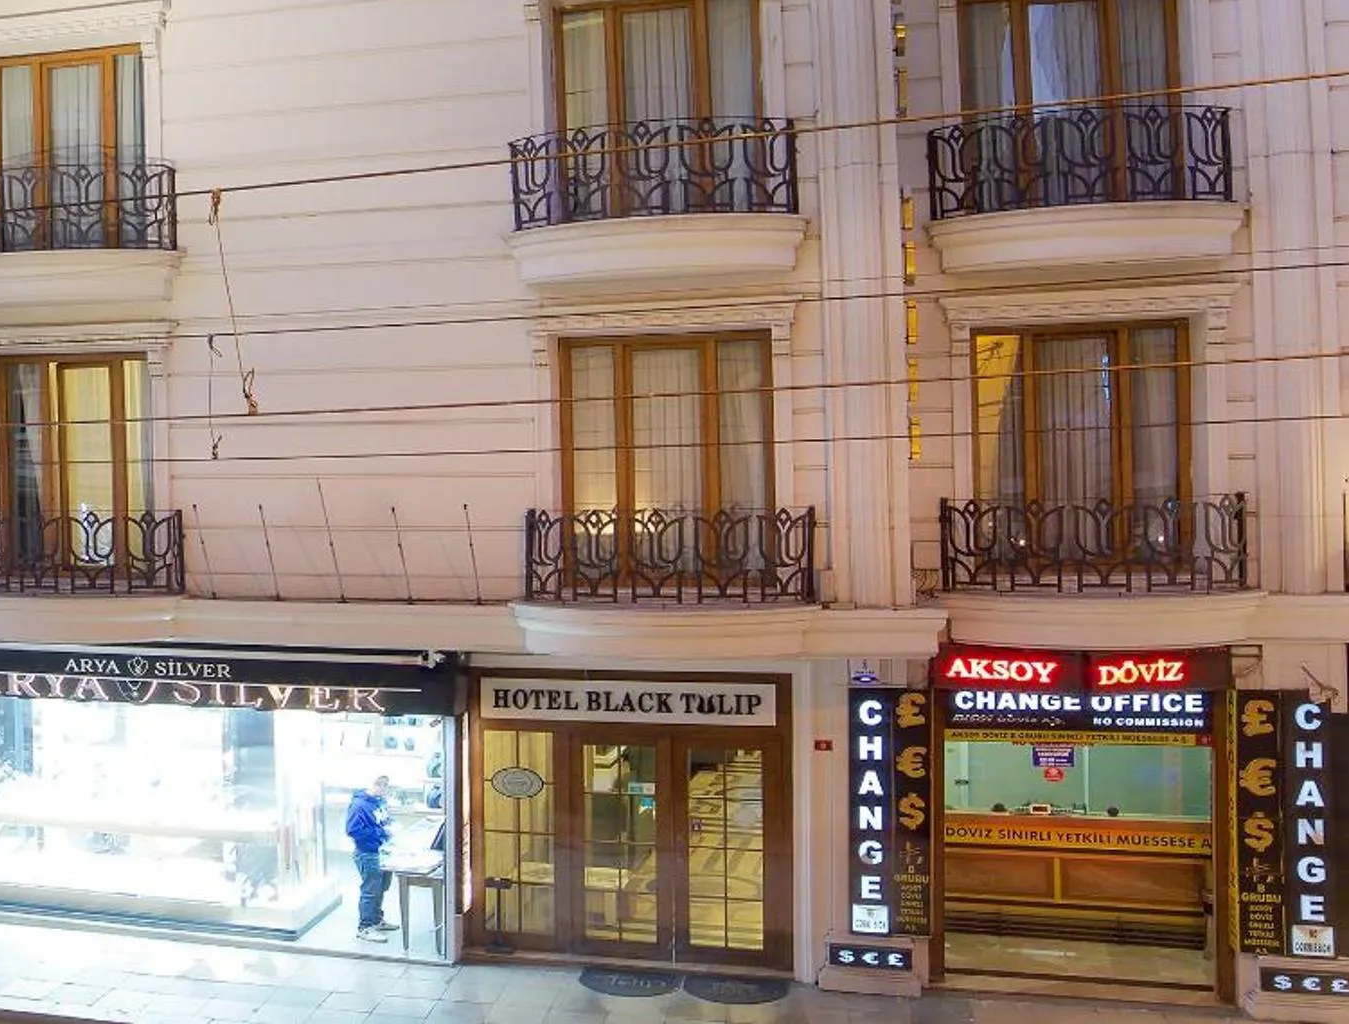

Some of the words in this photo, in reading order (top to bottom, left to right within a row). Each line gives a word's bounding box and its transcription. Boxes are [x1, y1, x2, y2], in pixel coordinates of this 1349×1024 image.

[65, 658, 121, 674] ARYA
[154, 659, 232, 678] SİLVER
[946, 658, 1059, 683] AKSOY
[492, 688, 578, 710] HOTEL
[586, 691, 673, 713] BLACK
[680, 693, 762, 715] TULIP
[955, 691, 1081, 710] CHANGE
[1091, 693, 1203, 713] OFFICE
[1093, 717, 1112, 726] NO
[1115, 717, 1203, 727] COMMISSION
[858, 700, 883, 900] CHANGE
[1295, 703, 1326, 922] CHANGE
